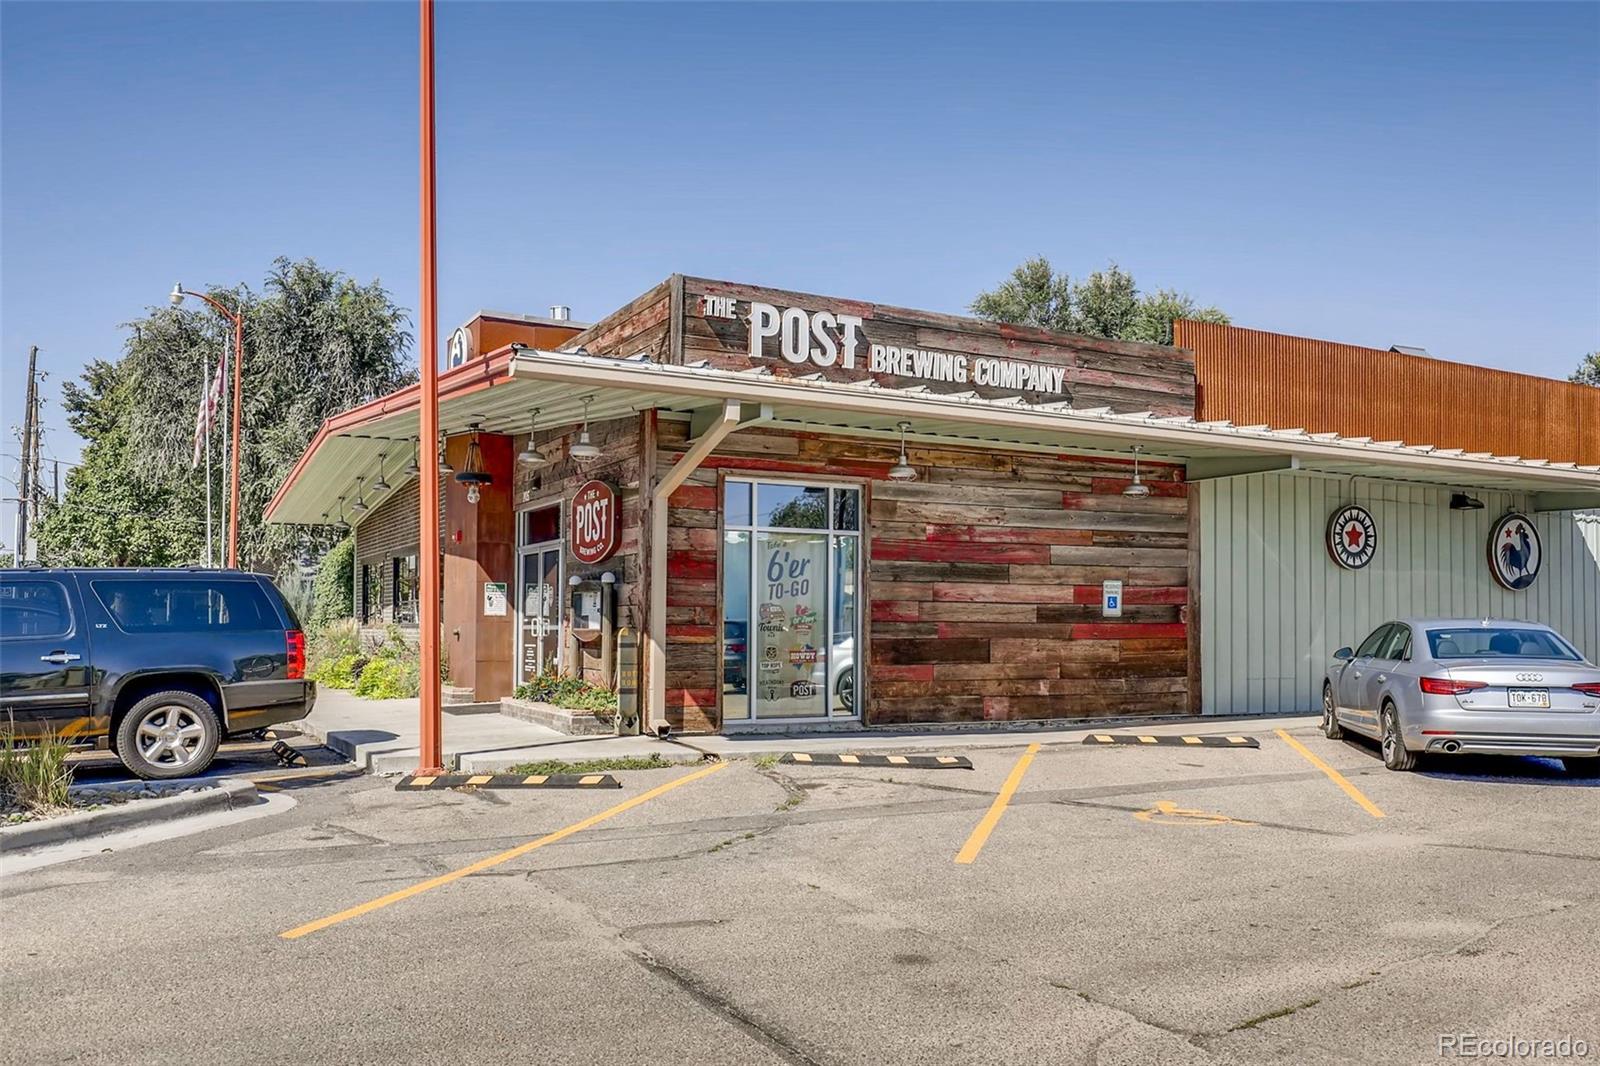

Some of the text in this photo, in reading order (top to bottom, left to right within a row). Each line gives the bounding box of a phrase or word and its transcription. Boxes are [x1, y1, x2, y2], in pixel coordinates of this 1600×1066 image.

[704, 294, 737, 320] THE
[744, 301, 863, 369] POST
[870, 344, 1066, 394] BREWING COMPANY
[587, 489, 596, 500] THE
[576, 498, 609, 545] POST
[579, 545, 597, 556] BREWING
[767, 549, 811, 583] 6'er
[768, 578, 810, 601] TO-GO
[792, 684, 814, 697] POST
